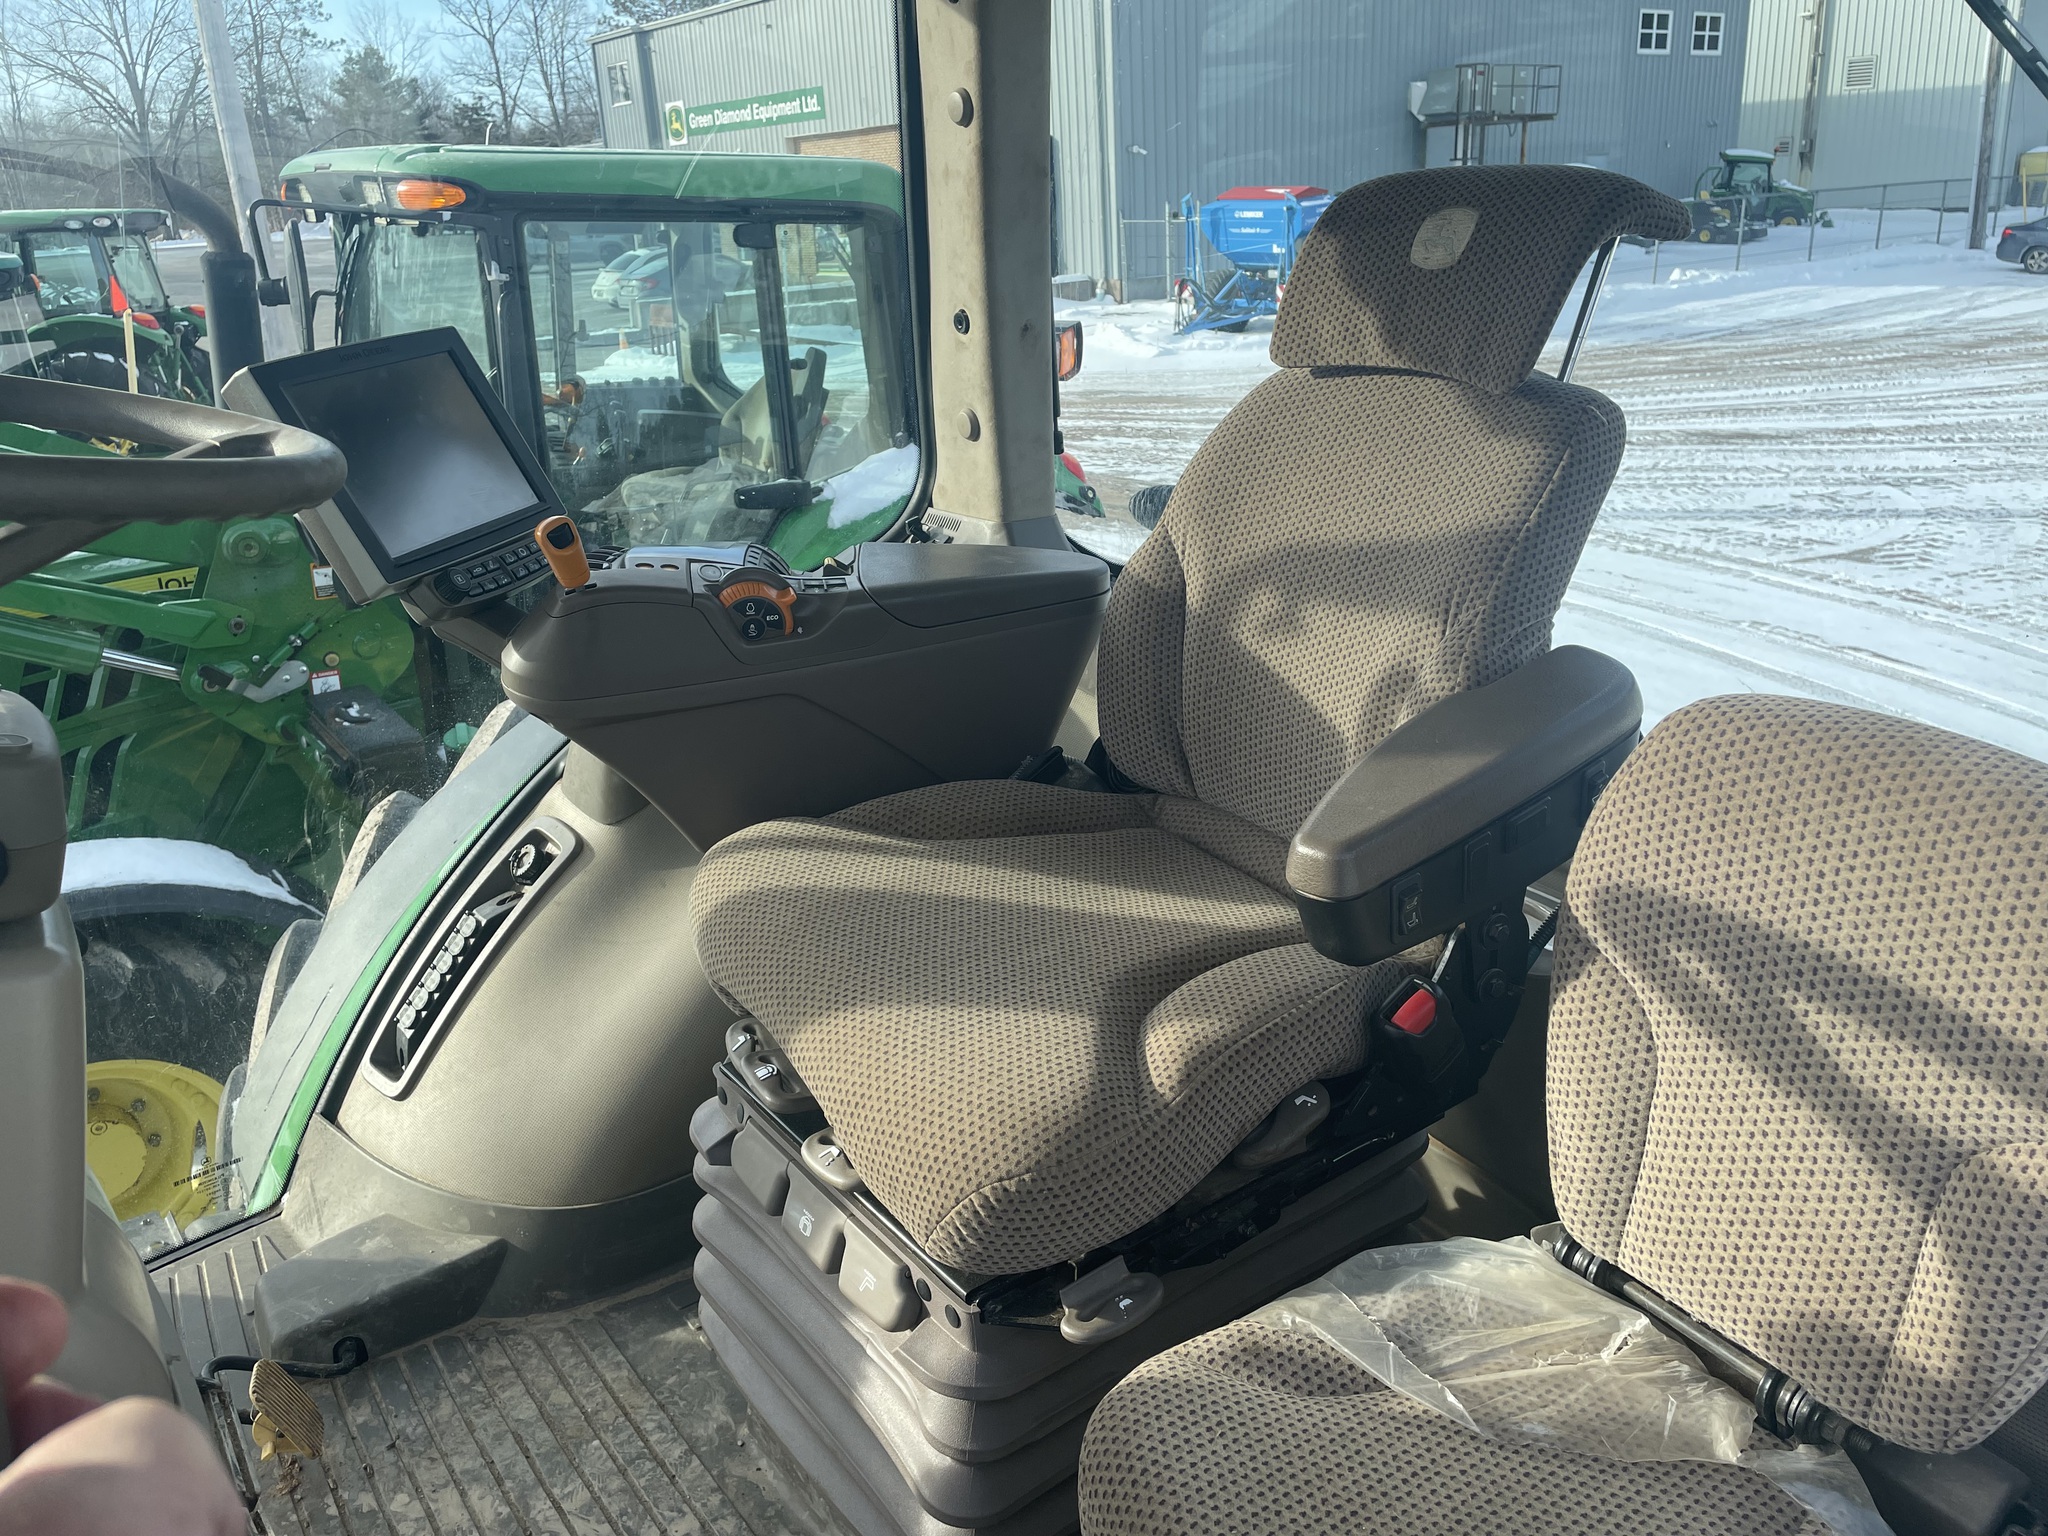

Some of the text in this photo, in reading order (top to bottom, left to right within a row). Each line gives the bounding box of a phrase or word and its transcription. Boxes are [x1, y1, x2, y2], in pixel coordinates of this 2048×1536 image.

[688, 93, 822, 129] Green Diamond Equipment Ltd.
